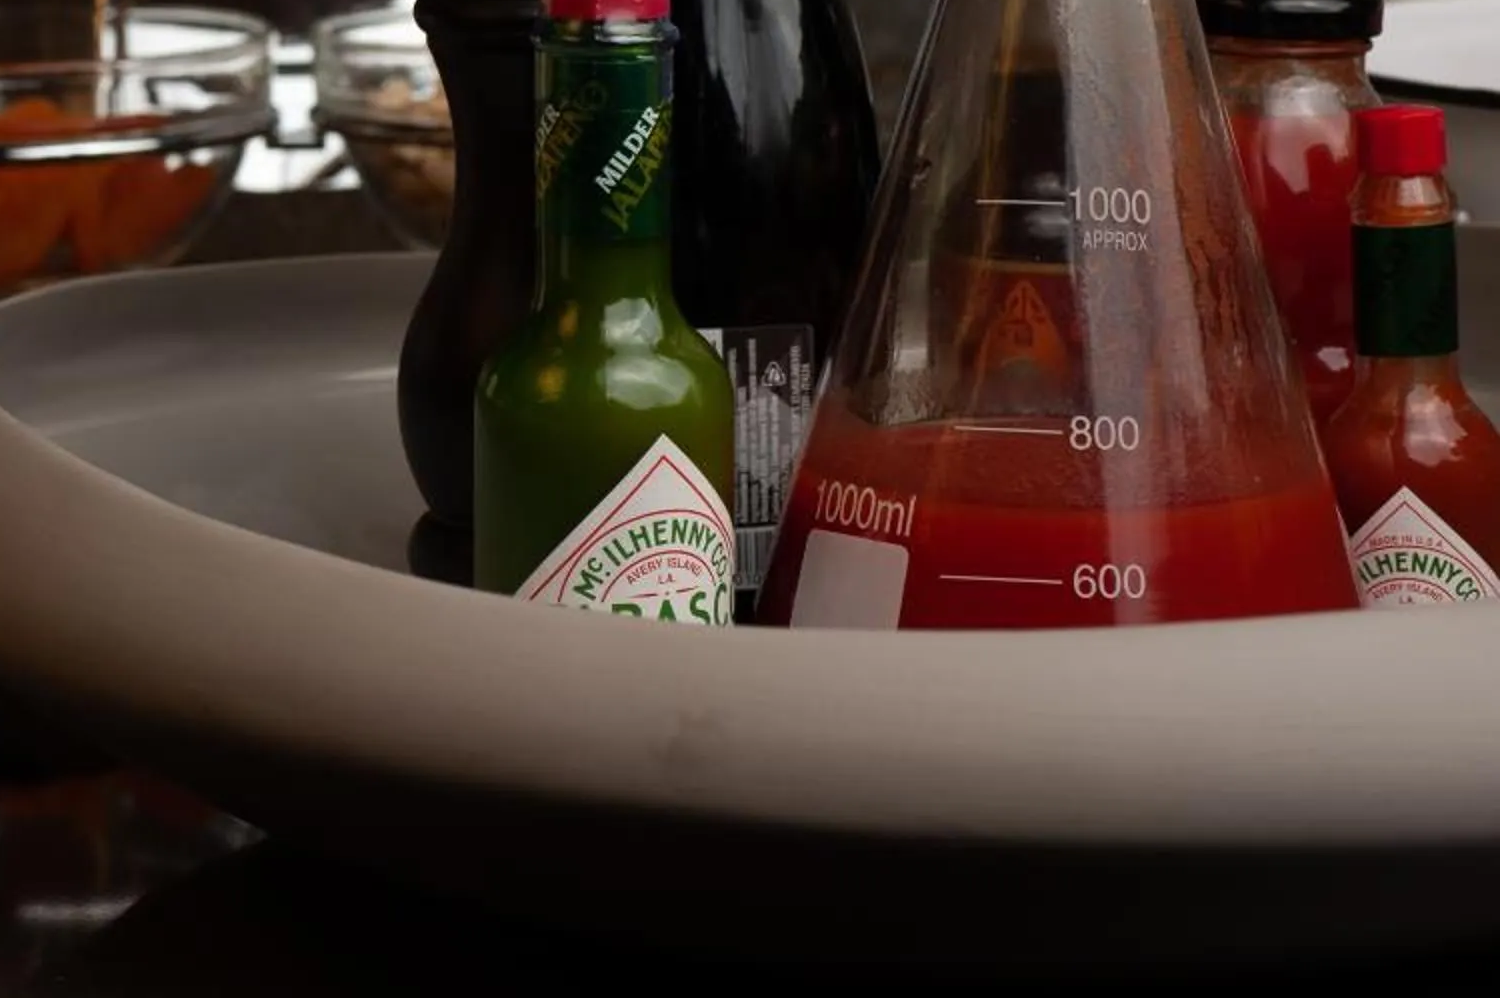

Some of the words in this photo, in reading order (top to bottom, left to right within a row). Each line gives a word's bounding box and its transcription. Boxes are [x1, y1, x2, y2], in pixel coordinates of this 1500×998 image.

[594, 106, 661, 194] MILDER
[1069, 186, 1151, 224] 1000
[1082, 229, 1147, 251] APPROX
[1069, 415, 1139, 450] 800
[814, 479, 917, 537] 1000ml
[1401, 534, 1413, 543] IN
[626, 557, 663, 585] AVERY
[1073, 564, 1146, 599] 600
[1357, 551, 1462, 584] ILHENNY
